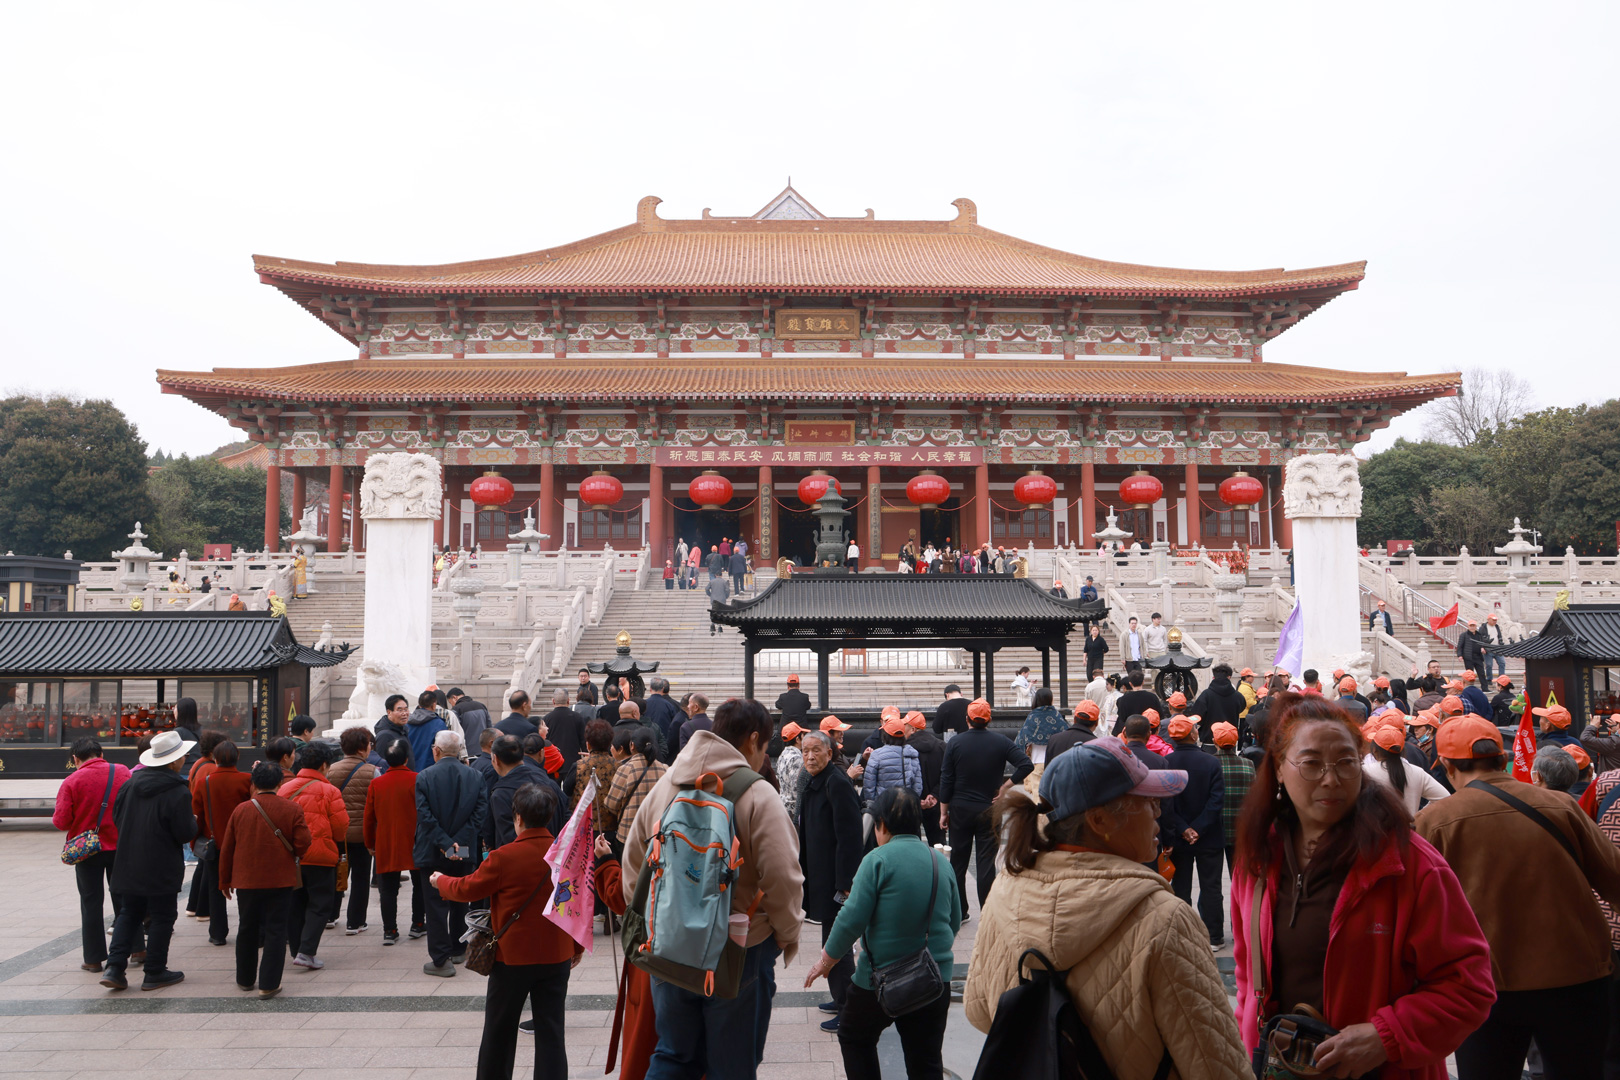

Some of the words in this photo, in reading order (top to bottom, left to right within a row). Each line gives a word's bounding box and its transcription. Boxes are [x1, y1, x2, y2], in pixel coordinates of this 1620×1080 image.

[669, 450, 763, 462] 祈愿国泰民安
[771, 450, 833, 462] 风调雨顺
[841, 451, 903, 462] 社会和谐
[911, 451, 972, 462] 人民幸福
